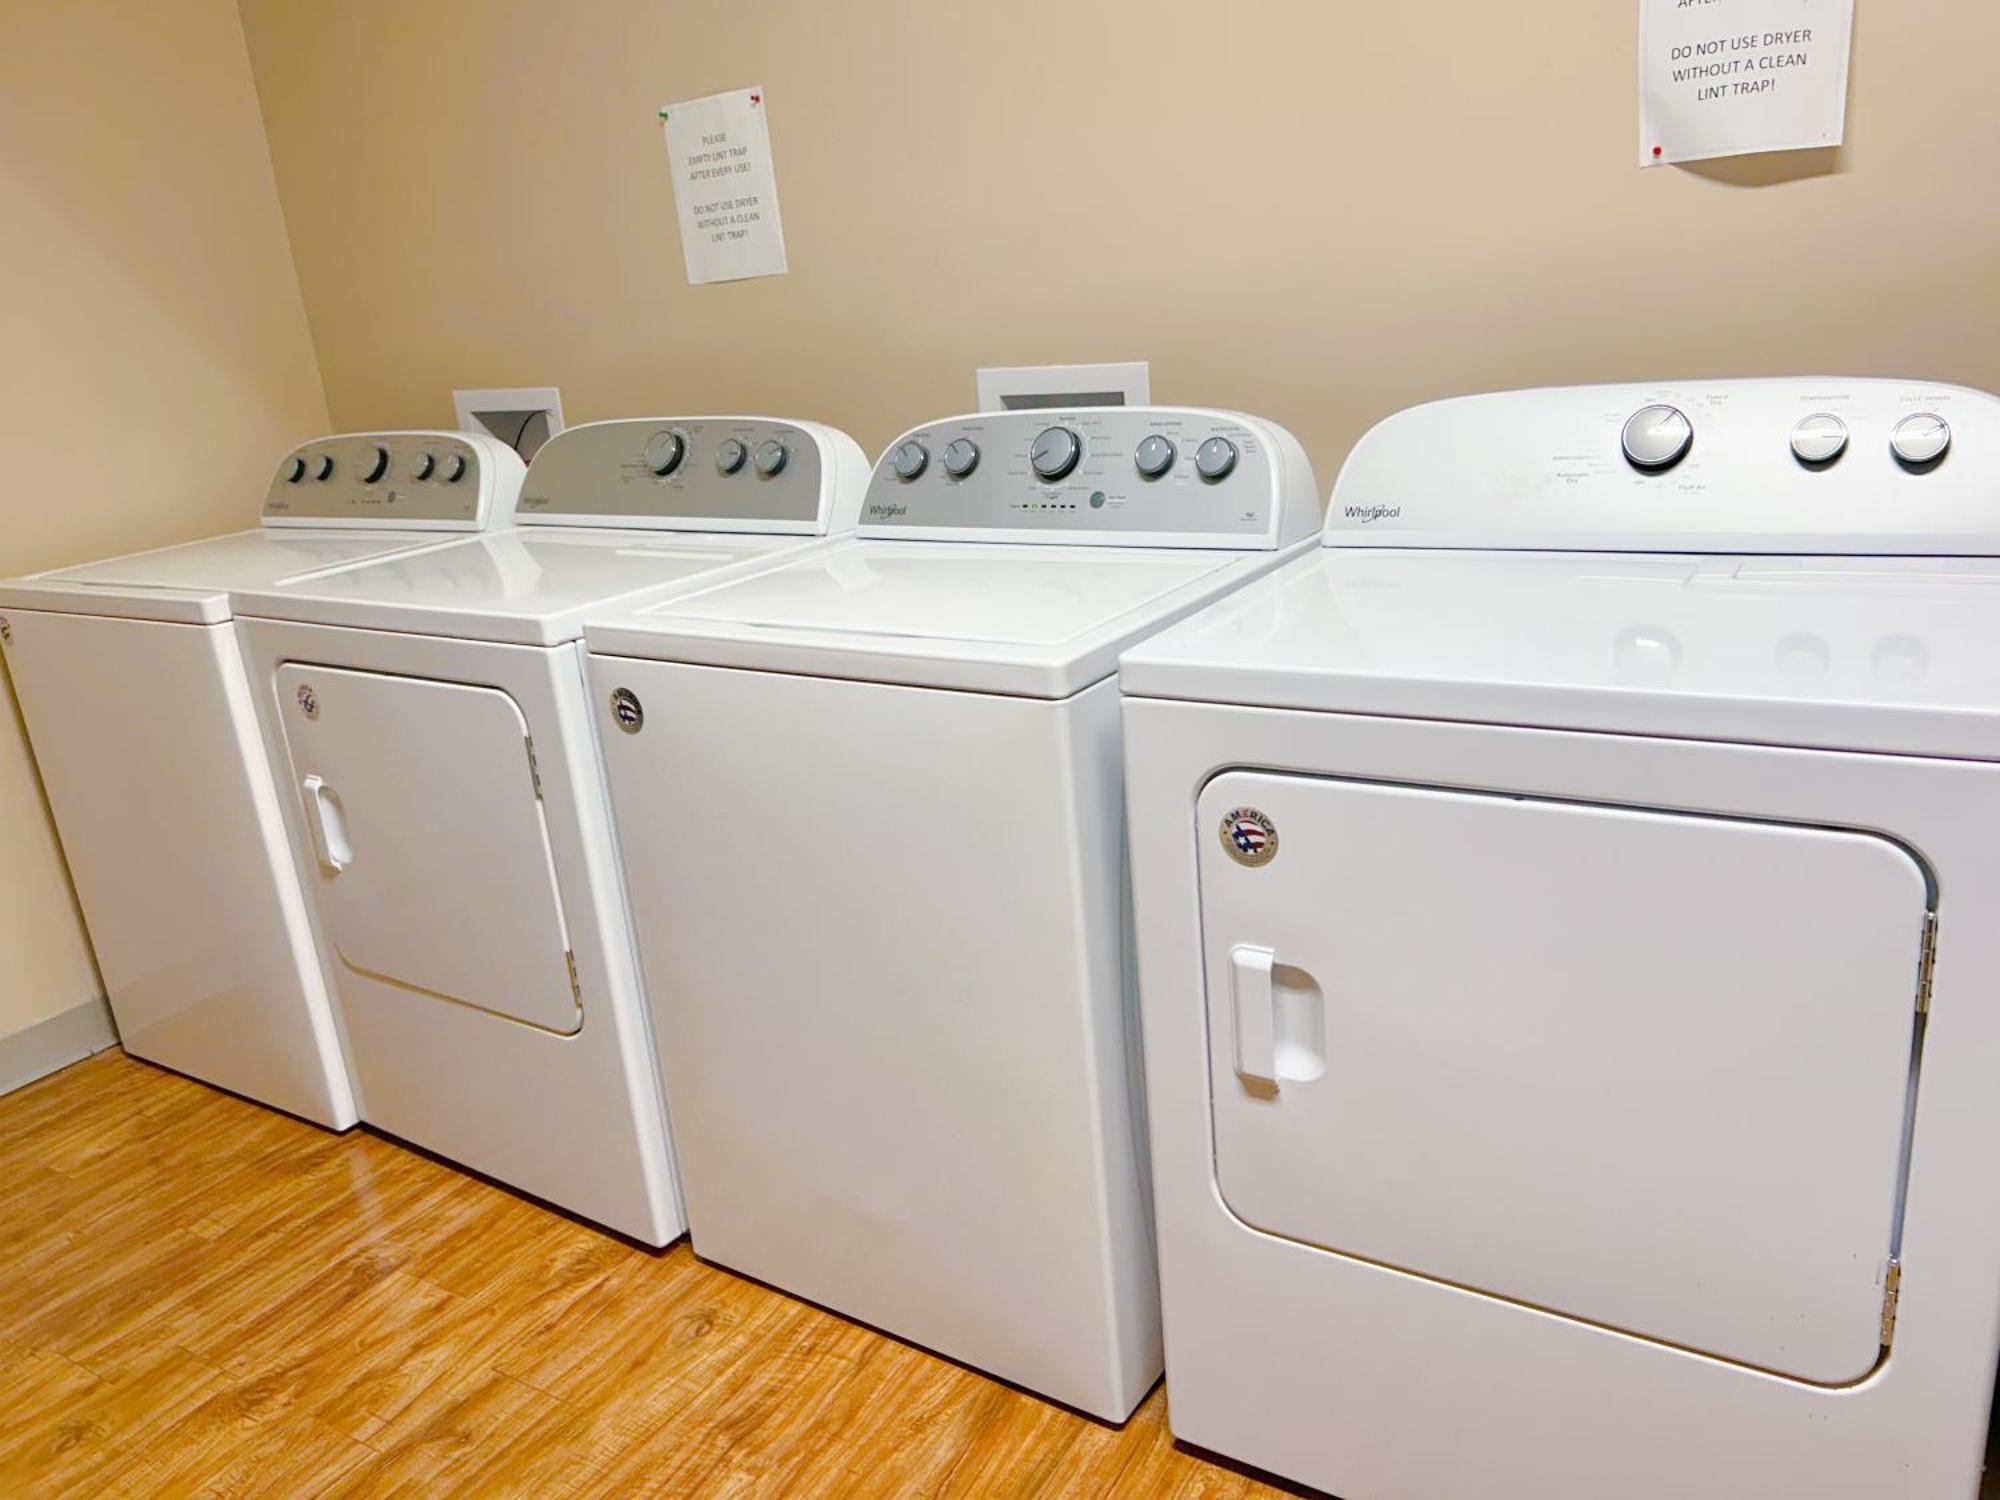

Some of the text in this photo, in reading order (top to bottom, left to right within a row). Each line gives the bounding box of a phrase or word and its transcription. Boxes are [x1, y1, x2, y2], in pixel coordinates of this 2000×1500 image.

[1671, 29, 1812, 60] DO NOT USE DRYER
[1672, 53, 1808, 82] WITHOUT A CLEAN
[1697, 79, 1775, 101] LINT TRAP!
[702, 132, 726, 145] PLEASE
[688, 147, 748, 166] EMPTY LINT TRAP
[690, 169, 711, 180] AFTER
[712, 165, 732, 177] EVERY
[693, 197, 759, 216] DO NOT USE DRYER
[697, 217, 728, 229] WITHOUT
[736, 212, 760, 224] CLEAN
[711, 232, 726, 244] LINT
[1344, 504, 1401, 523] Whirlpool
[1224, 809, 1275, 837] AMERICA
